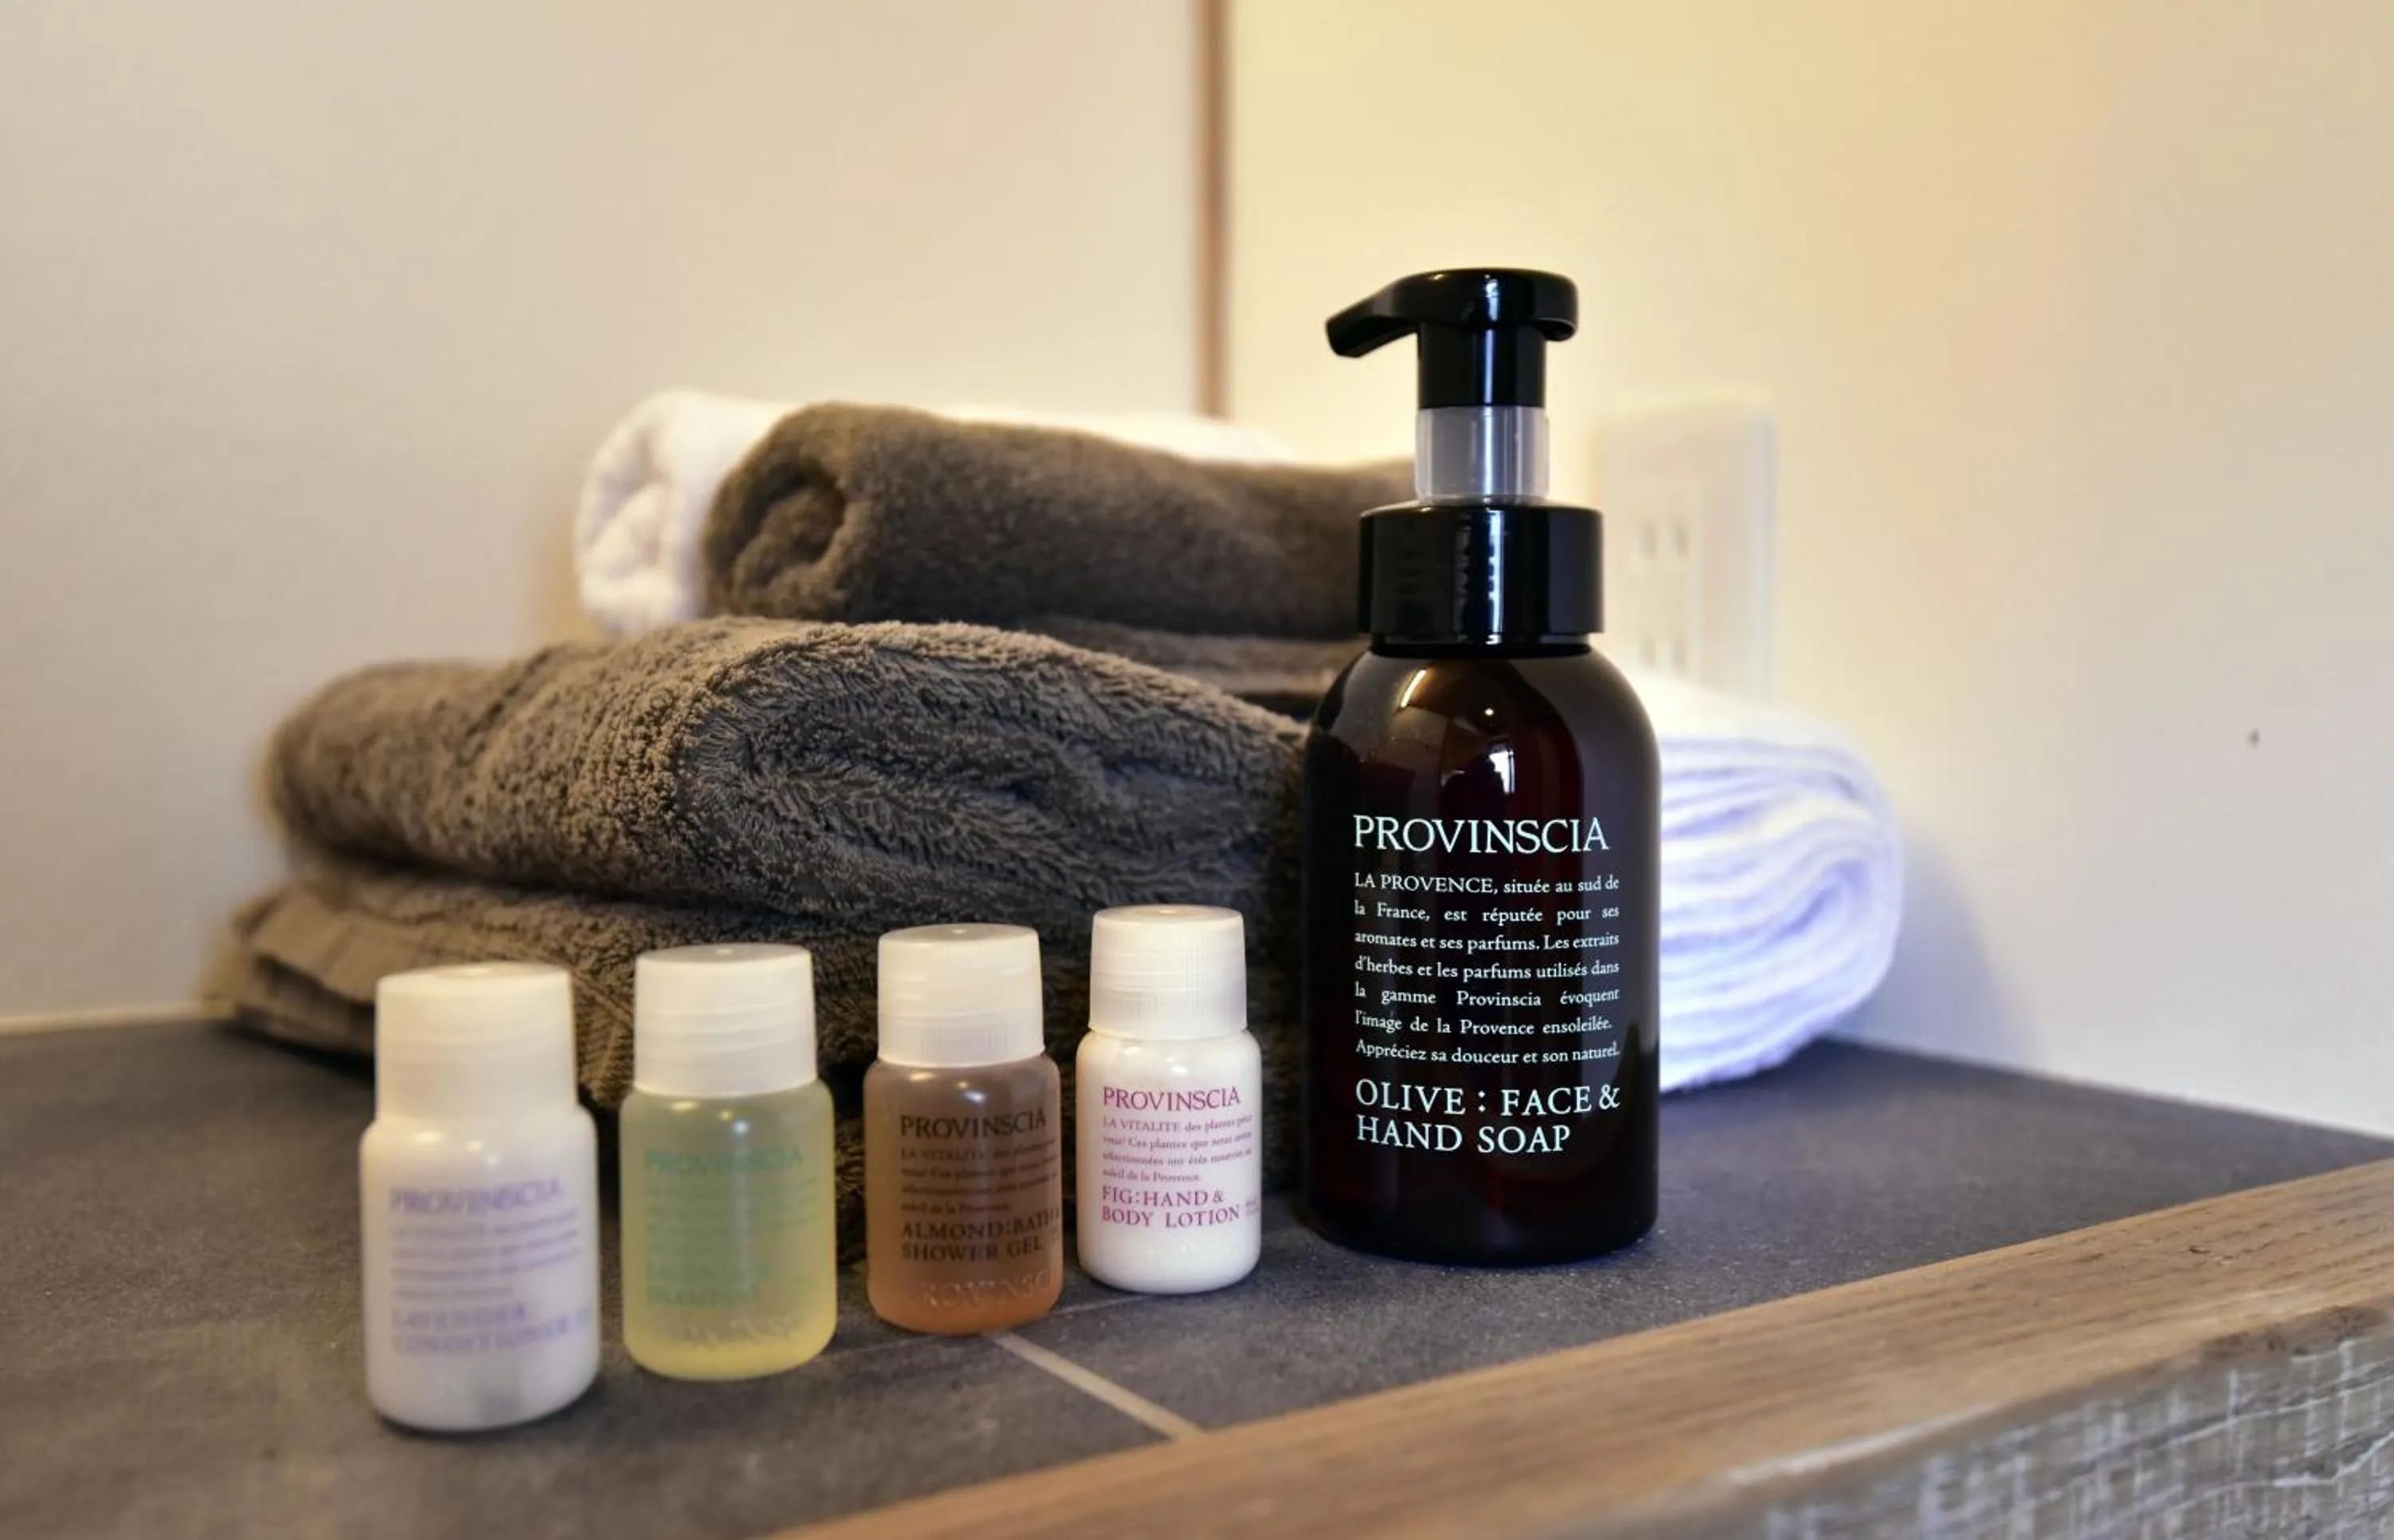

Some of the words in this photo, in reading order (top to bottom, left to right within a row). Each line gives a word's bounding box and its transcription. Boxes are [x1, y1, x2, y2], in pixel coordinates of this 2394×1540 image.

[1353, 814, 1610, 855] PROVINSCIA
[1354, 871, 1377, 889] LA
[1380, 873, 1499, 895] PROVENCE,
[1503, 878, 1551, 894] située
[1555, 882, 1574, 893] au
[1577, 875, 1602, 891] sud
[1604, 874, 1620, 890] de
[1354, 898, 1366, 916] la
[1377, 901, 1431, 922] France,
[1444, 910, 1468, 922] est
[1482, 907, 1543, 927] réputée
[1556, 909, 1592, 926] pour
[1602, 906, 1620, 919] ses
[1354, 931, 1418, 948] aromates
[1420, 938, 1436, 949] et
[1439, 938, 1464, 950] ses
[1467, 934, 1541, 955] parfums.
[1543, 934, 1570, 950] Les
[1572, 931, 1620, 949] extraits
[1416, 965, 1433, 977] et
[1436, 961, 1459, 977] les
[1463, 962, 1532, 984] parfums
[1535, 962, 1588, 979] utilisés
[1591, 959, 1621, 976] dans
[1354, 981, 1367, 998] la
[1381, 989, 1437, 1006] gamme
[1456, 989, 1543, 1007] Provinscia
[1559, 989, 1620, 1009] évoquent
[1409, 1015, 1429, 1033] de
[1436, 1017, 1452, 1033] la
[1459, 1018, 1535, 1036] Provence
[1355, 1038, 1428, 1060] Appréciez
[1430, 1051, 1448, 1062] sa
[1450, 1046, 1520, 1064] douceur
[1522, 1052, 1539, 1064] et
[1541, 1051, 1569, 1064] son
[1103, 1086, 1241, 1112] PROVINSCIA
[1355, 1078, 1466, 1115] OLIVE
[1499, 1085, 1593, 1117] FACE
[1598, 1084, 1621, 1111] &
[900, 1108, 1048, 1139] PROVINSCIA
[1357, 1114, 1464, 1151] HAND
[1476, 1123, 1571, 1155] SOAP
[1212, 1190, 1225, 1203] &
[1101, 1206, 1154, 1227] BODY
[1165, 1206, 1240, 1228] LOTION
[901, 1242, 999, 1262] SHOWER
[1006, 1236, 1042, 1258] GEL
